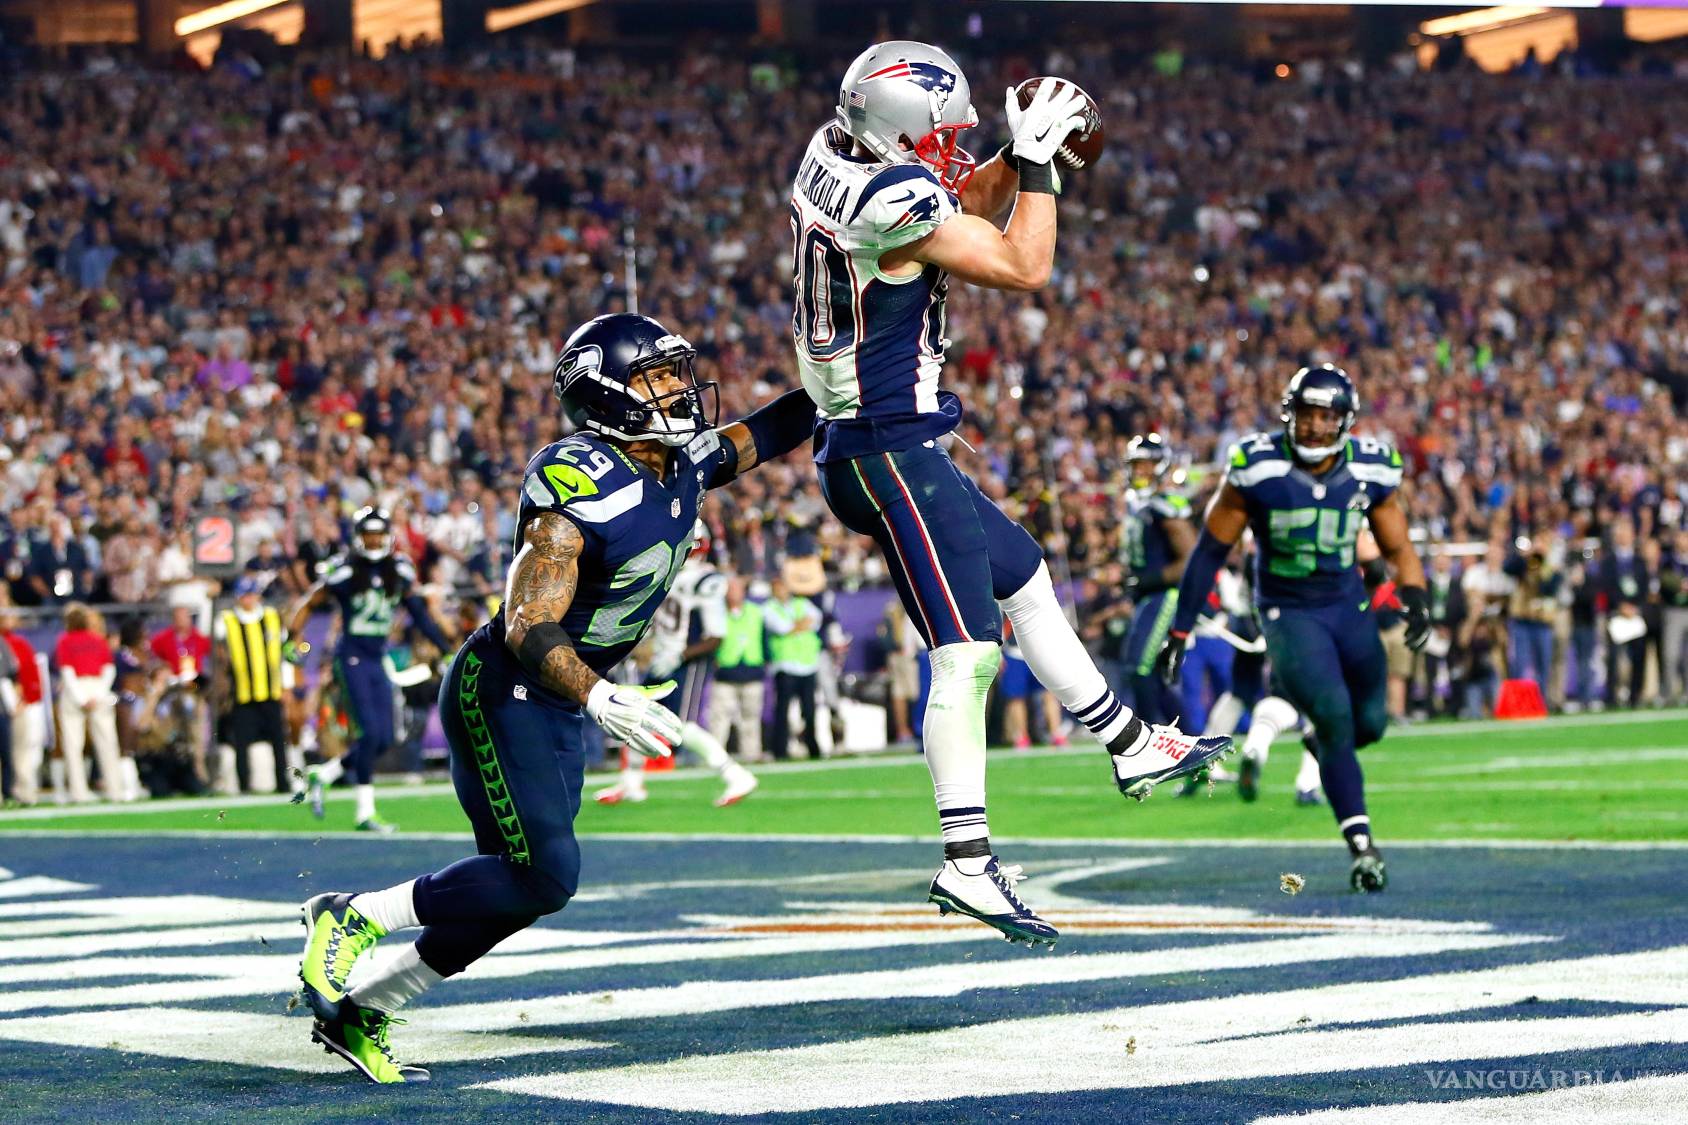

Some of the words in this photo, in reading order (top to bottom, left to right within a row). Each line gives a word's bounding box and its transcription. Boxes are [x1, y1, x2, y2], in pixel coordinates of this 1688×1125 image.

[555, 441, 614, 481] 29
[196, 515, 234, 563] 2
[1269, 507, 1363, 578] 54
